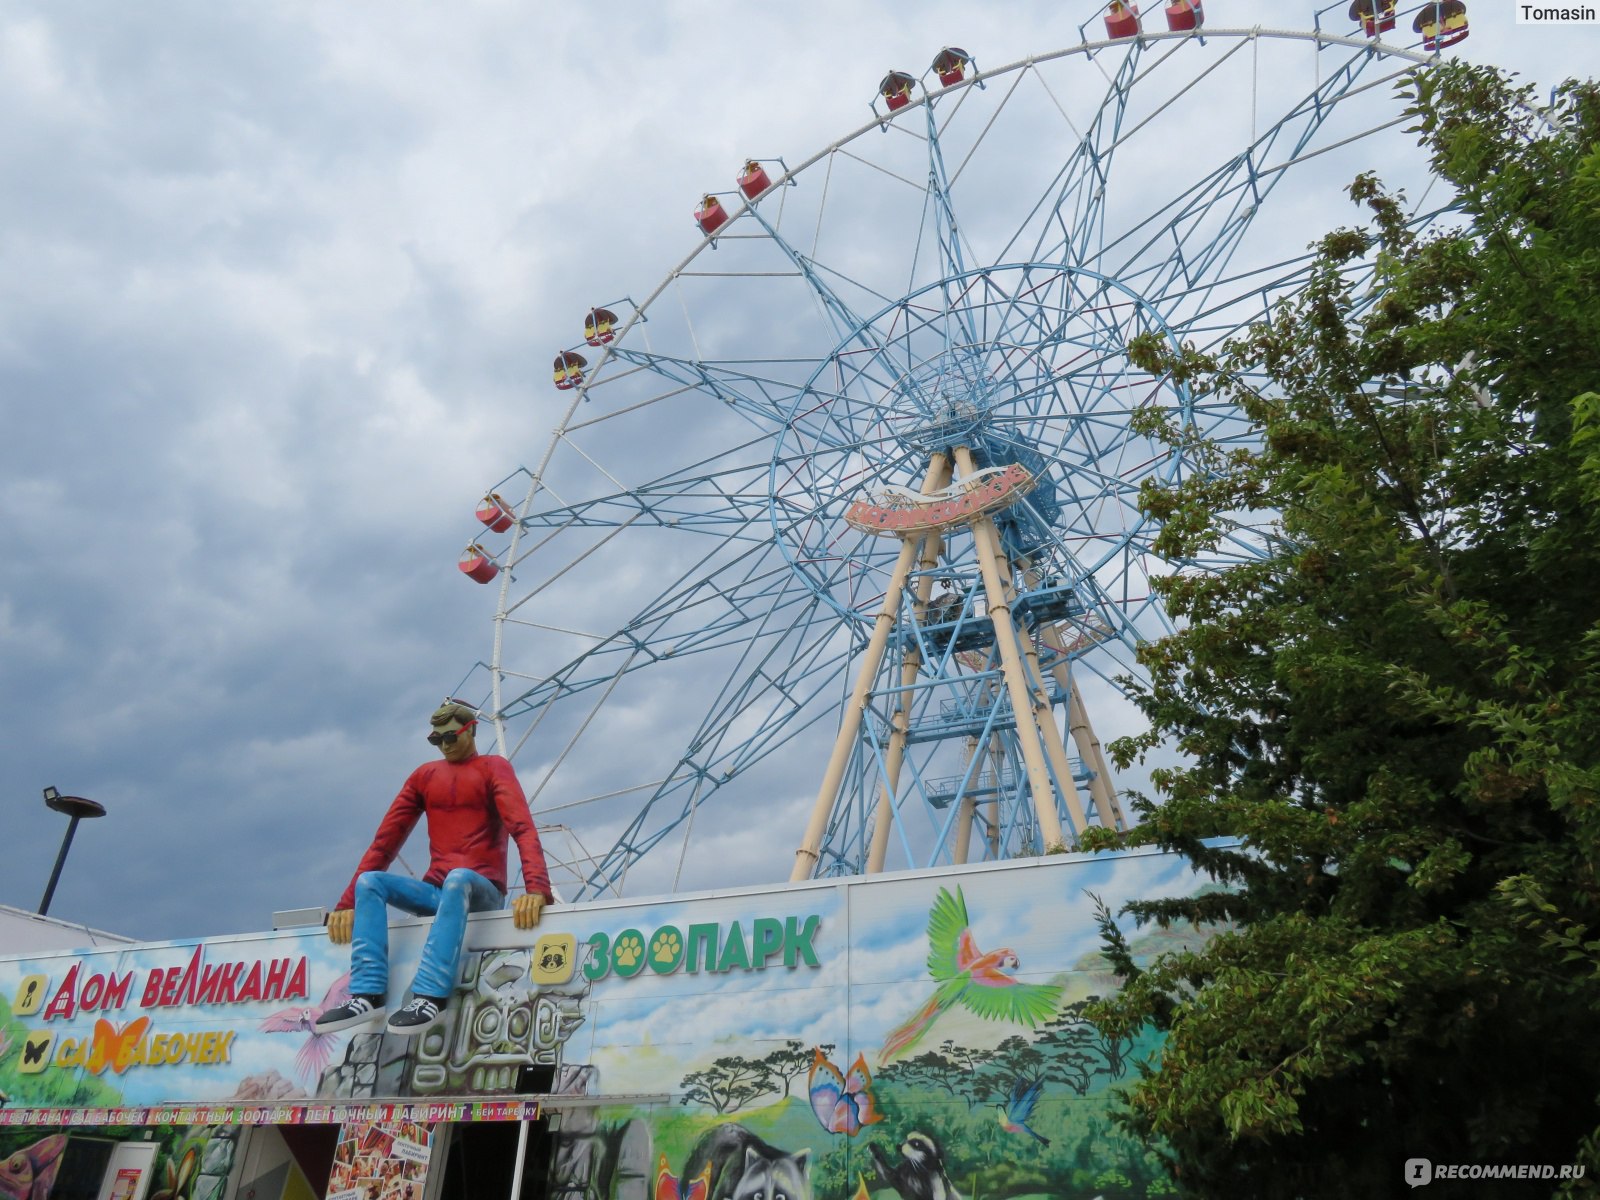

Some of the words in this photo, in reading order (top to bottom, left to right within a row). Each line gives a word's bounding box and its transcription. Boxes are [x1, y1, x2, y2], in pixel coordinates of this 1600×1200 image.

[583, 914, 821, 982] ЗООПАРК
[140, 943, 308, 1009] ВЕЛИКАНА
[118, 1029, 236, 1067] БАБОЧЕК
[155, 1110, 234, 1122] КОНТАКТНЫЙ
[237, 1109, 295, 1122] ЗООПАРК
[305, 1108, 388, 1121] ЛЕНТОЧНЫЙ
[391, 1106, 467, 1120] ЛАБИРИНТ
